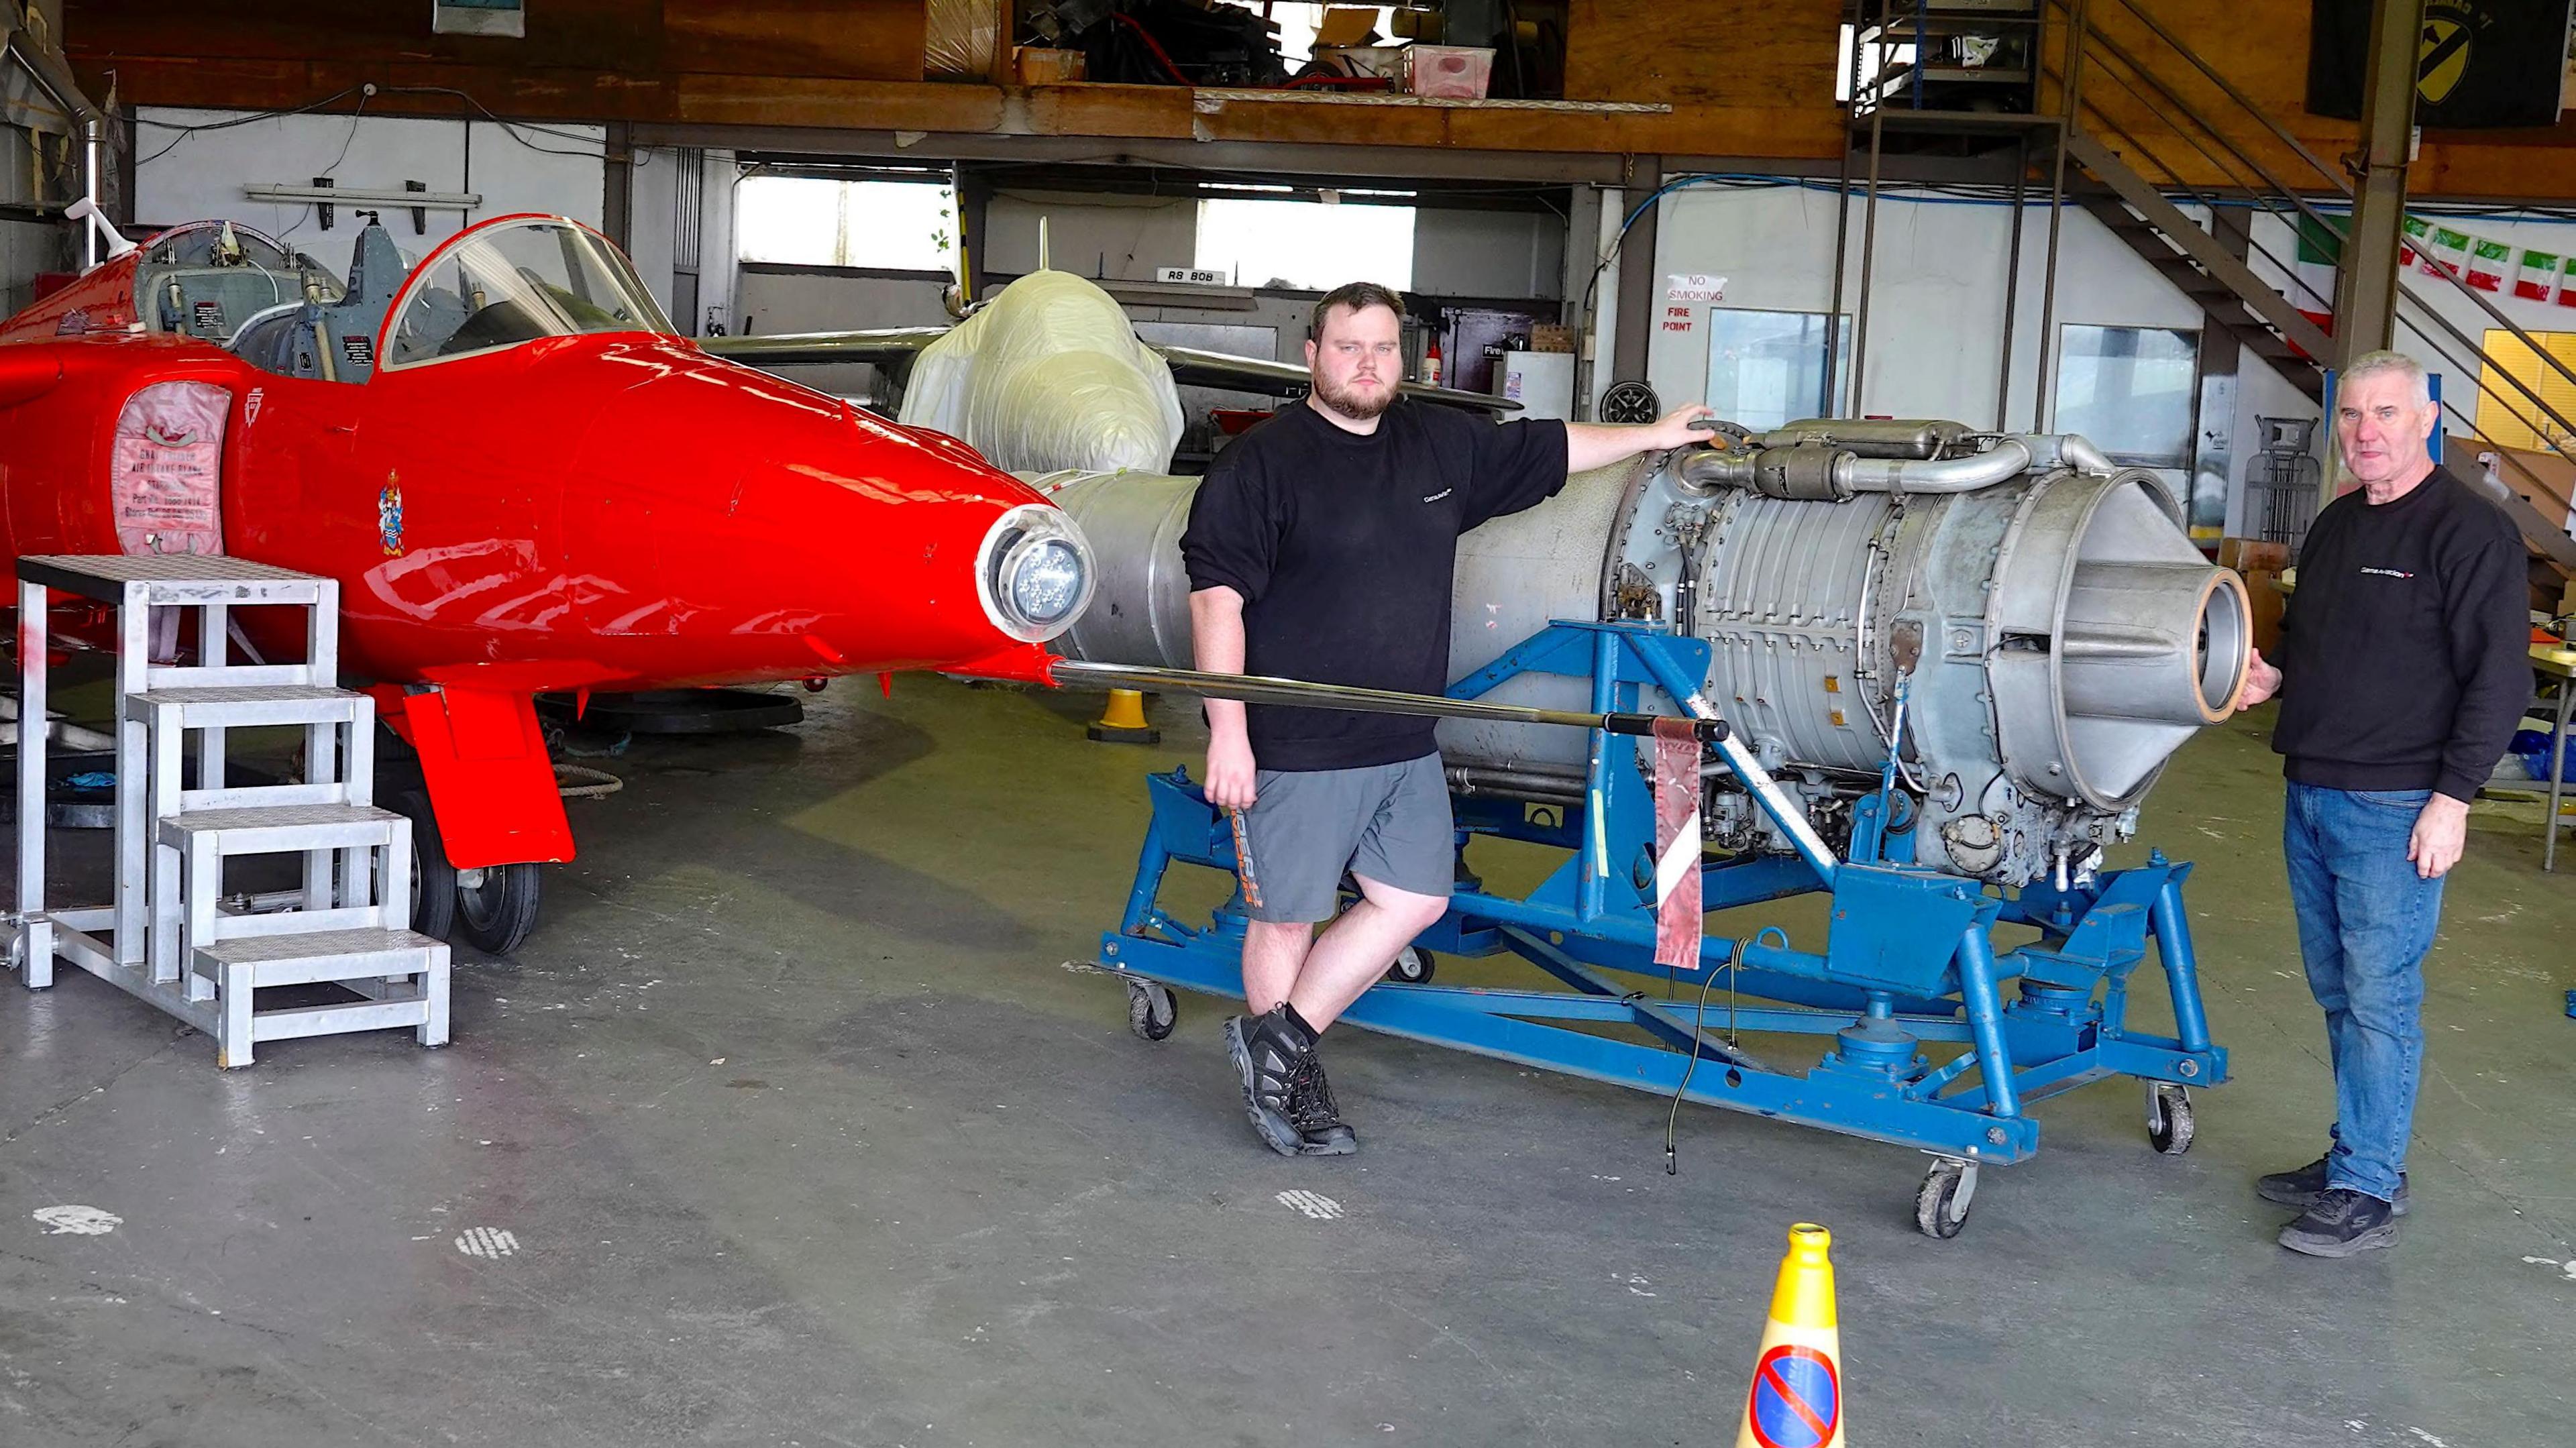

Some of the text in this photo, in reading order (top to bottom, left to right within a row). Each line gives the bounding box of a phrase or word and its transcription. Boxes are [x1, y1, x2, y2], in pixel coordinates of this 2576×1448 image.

[1688, 276, 1706, 285] NO
[1669, 290, 1723, 300] SMOKING
[1668, 307, 1690, 317] FIRE
[1663, 322, 1692, 331] POINT
[1485, 346, 1501, 355] Fire
[1237, 810, 1254, 878] DER
